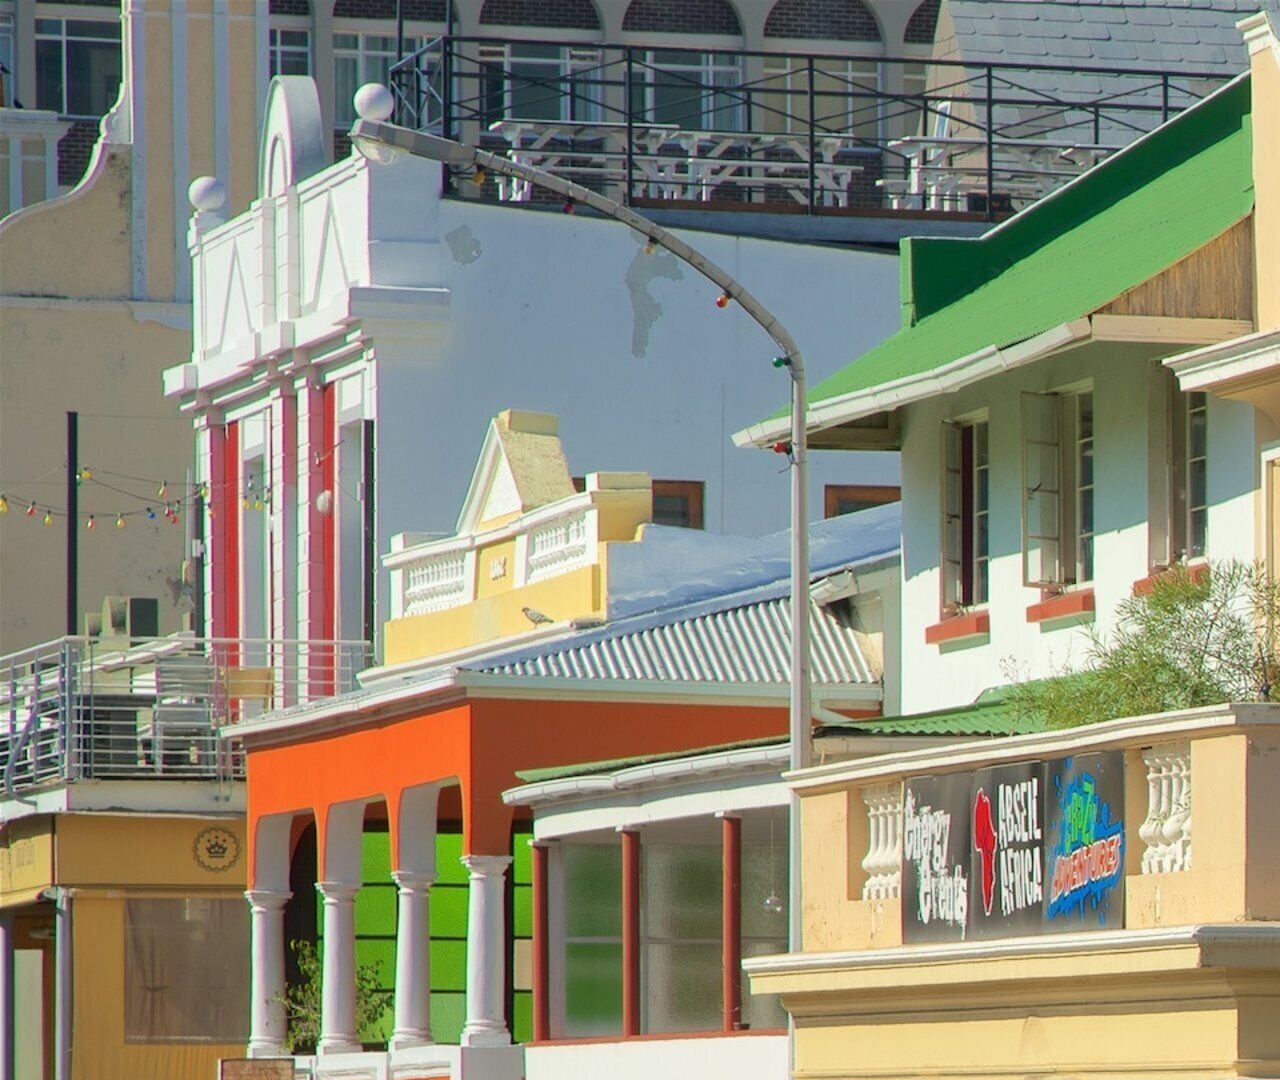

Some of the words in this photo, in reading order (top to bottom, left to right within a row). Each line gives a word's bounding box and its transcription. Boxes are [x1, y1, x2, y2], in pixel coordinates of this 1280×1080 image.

[999, 777, 1041, 848] ABSEIL
[1000, 847, 1043, 916] AFRICA
[1051, 834, 1122, 904] ADVENTURES
